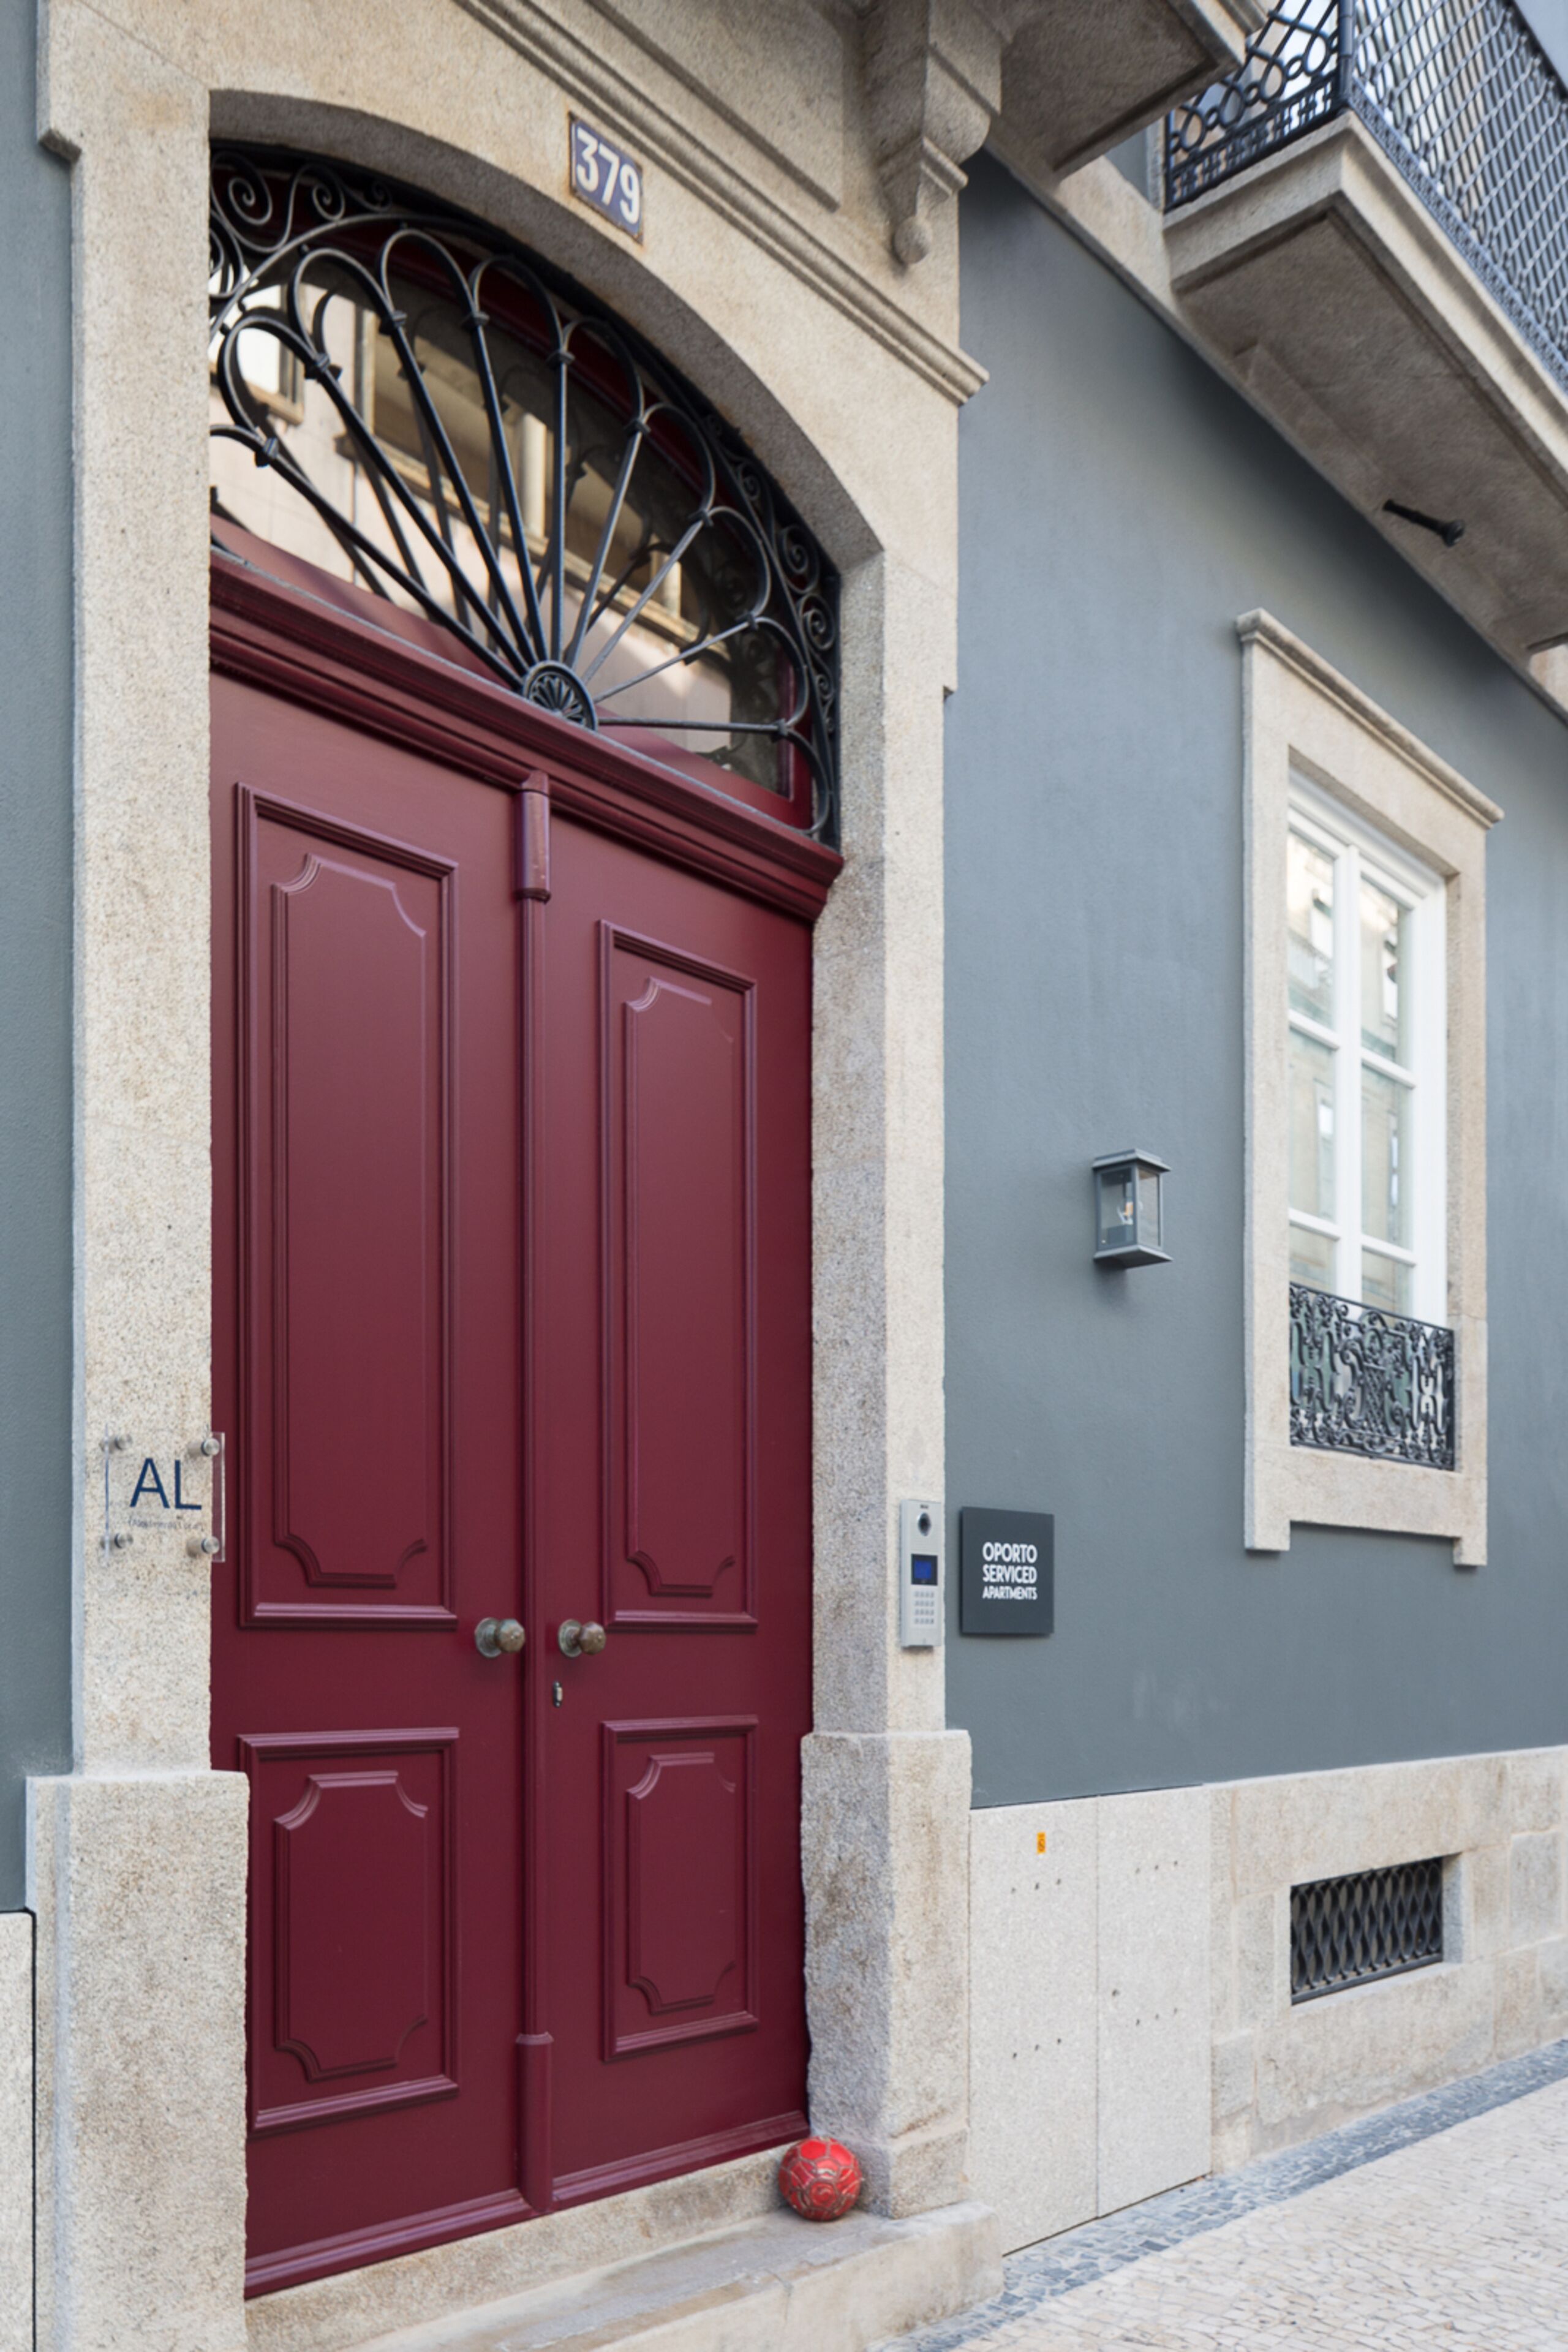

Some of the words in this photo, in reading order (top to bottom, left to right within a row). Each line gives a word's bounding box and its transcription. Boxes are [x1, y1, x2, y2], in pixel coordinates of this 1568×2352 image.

[576, 126, 639, 224] 379
[129, 1458, 202, 1510] AL
[982, 1542, 1038, 1563] OPORTO
[982, 1564, 1038, 1584] SERVICED
[982, 1586, 1038, 1600] APARTMENTS
